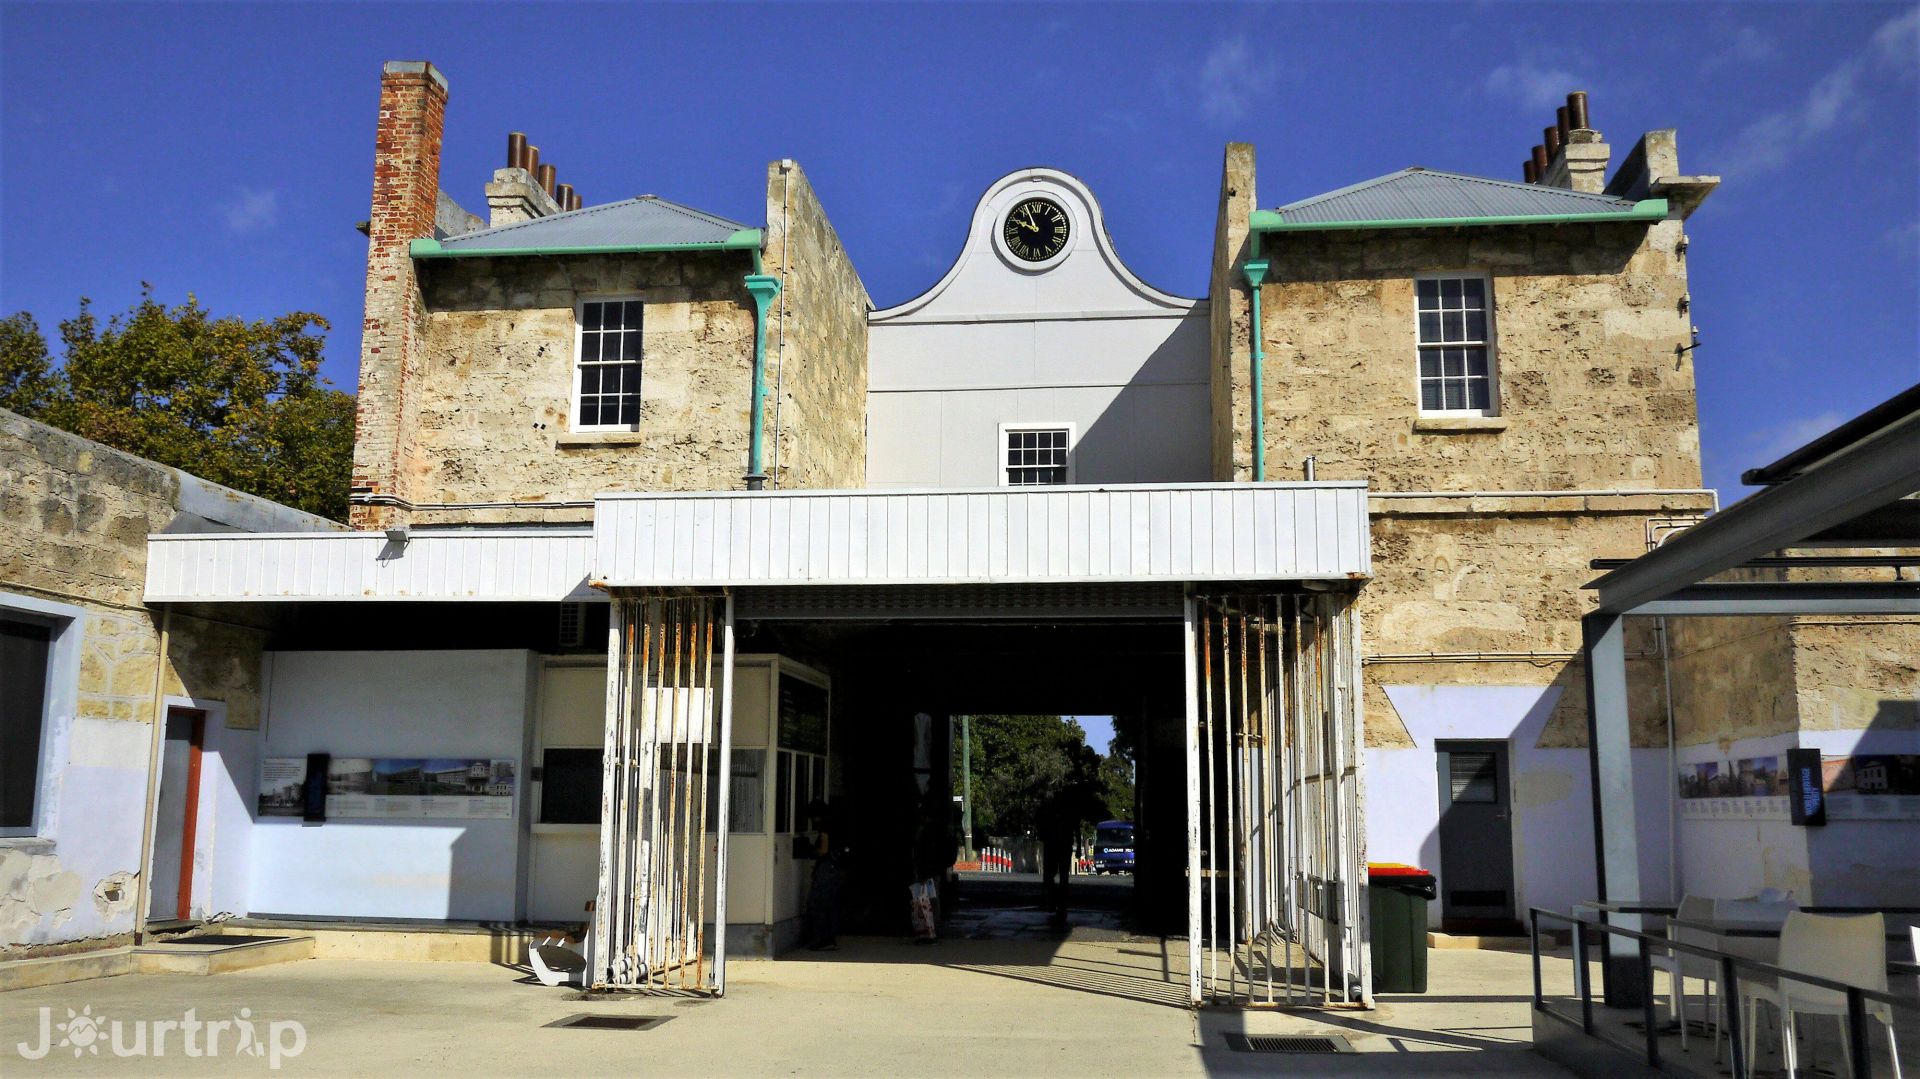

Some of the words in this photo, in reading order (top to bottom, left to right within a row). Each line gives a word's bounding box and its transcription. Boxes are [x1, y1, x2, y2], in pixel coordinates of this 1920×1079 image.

[1031, 204, 1042, 214] XII
[1044, 206, 1051, 215] I
[1051, 214, 1062, 223] II
[1008, 227, 1018, 235] IX
[1054, 226, 1064, 234] III
[1019, 245, 1029, 256] VII
[1033, 247, 1041, 257] VI
